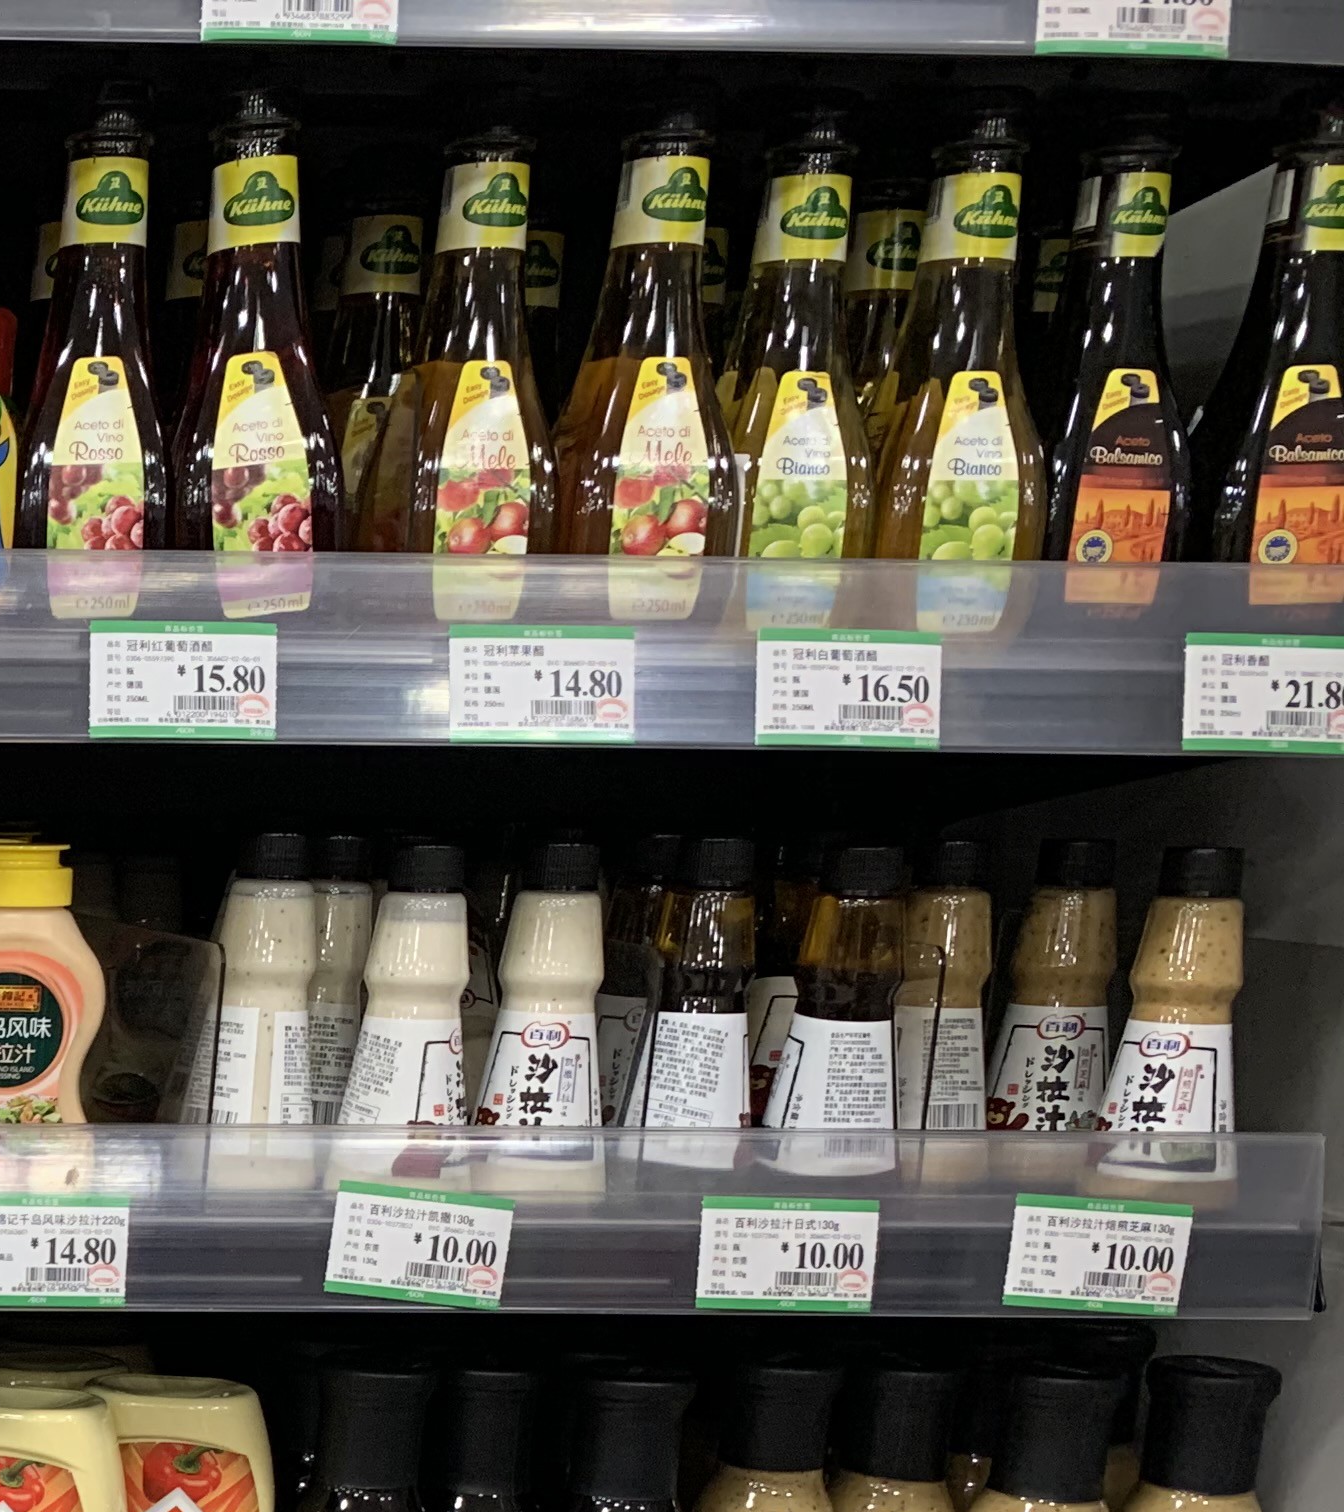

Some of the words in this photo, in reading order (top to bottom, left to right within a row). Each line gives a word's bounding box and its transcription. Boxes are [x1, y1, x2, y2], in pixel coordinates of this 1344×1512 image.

[82, 196, 143, 215] Kühne
[230, 197, 292, 217] Kühne
[68, 440, 124, 461] Rosso
[1089, 445, 1163, 467] Balsamico
[947, 457, 1003, 477] Bianco
[125, 640, 213, 653] 冠利红葡萄酒醋
[483, 645, 545, 658] 冠利苹果醋
[193, 664, 266, 694] 15.80
[549, 669, 622, 698] 14.80
[858, 675, 930, 703] 16.50
[529, 1029, 562, 1043] 百利
[45, 1238, 116, 1265] 14.80
[429, 1236, 498, 1267] 10.00
[796, 1242, 864, 1270] 10.00
[1105, 1244, 1173, 1273] 10.00
